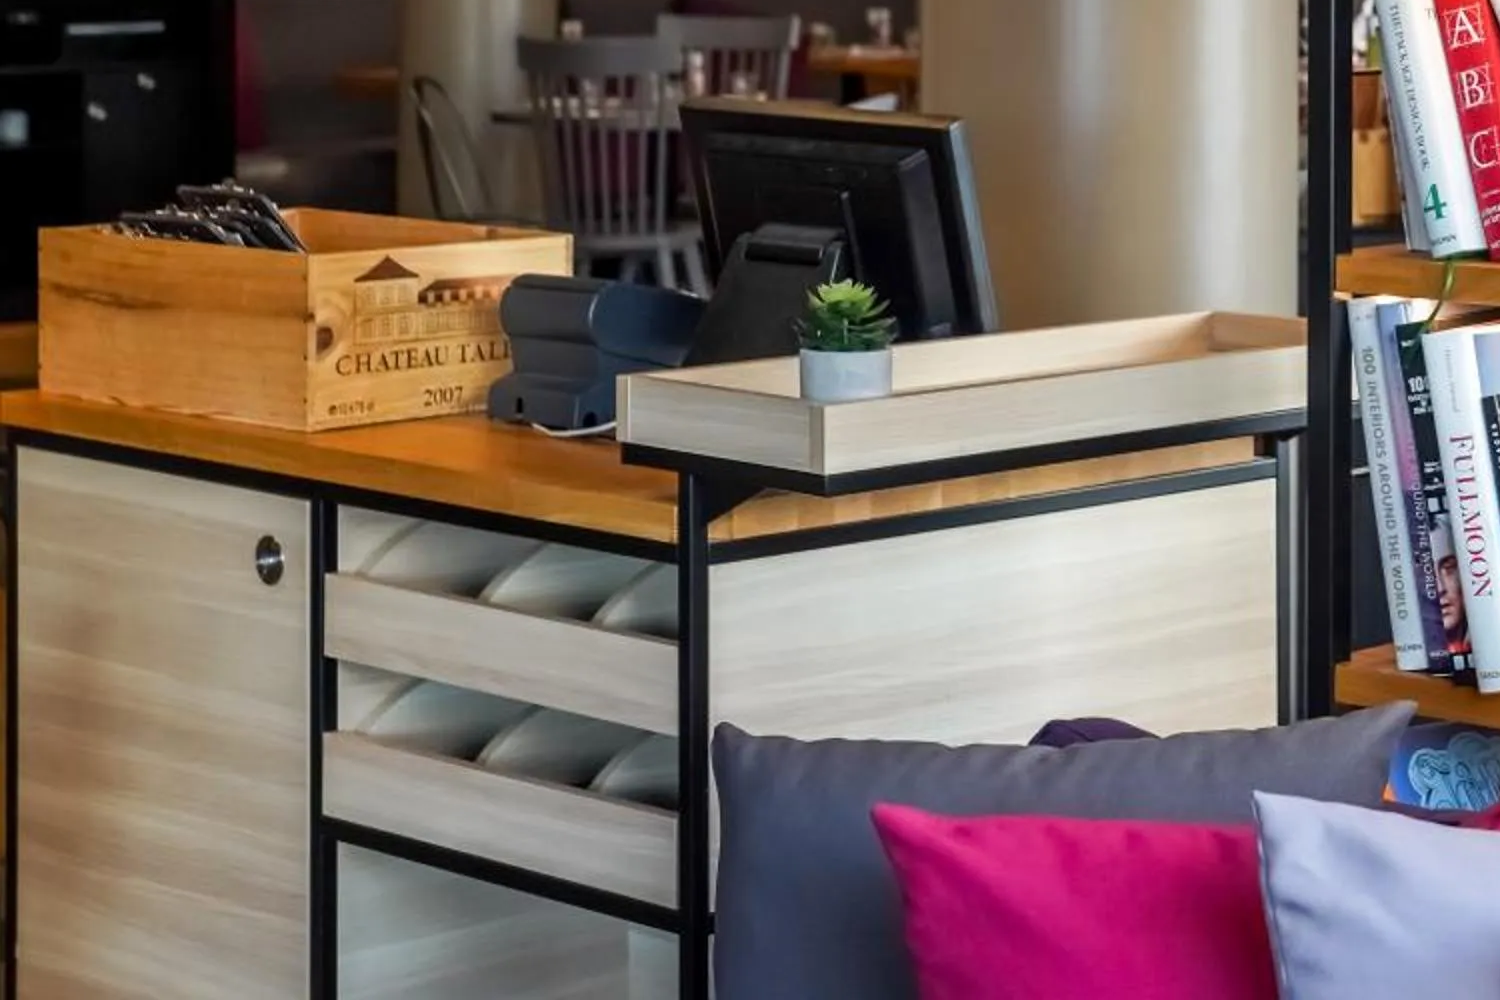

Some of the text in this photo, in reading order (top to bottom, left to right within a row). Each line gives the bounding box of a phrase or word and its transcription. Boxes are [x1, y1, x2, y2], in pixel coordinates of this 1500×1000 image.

[1451, 8, 1483, 48] A
[1392, 27, 1414, 86] PACKAGE
[1405, 88, 1424, 134] DESIGN
[1461, 70, 1484, 109] B
[1470, 131, 1499, 169] C
[1424, 183, 1447, 220] 4
[335, 345, 449, 377] CHATEAU
[424, 386, 464, 407] 2007
[1362, 346, 1409, 621] 100 INTERIORS AROUND THE WORLD
[1449, 434, 1494, 598] FULLMOON
[1416, 524, 1430, 550] THE
[1422, 551, 1437, 600] WORLD
